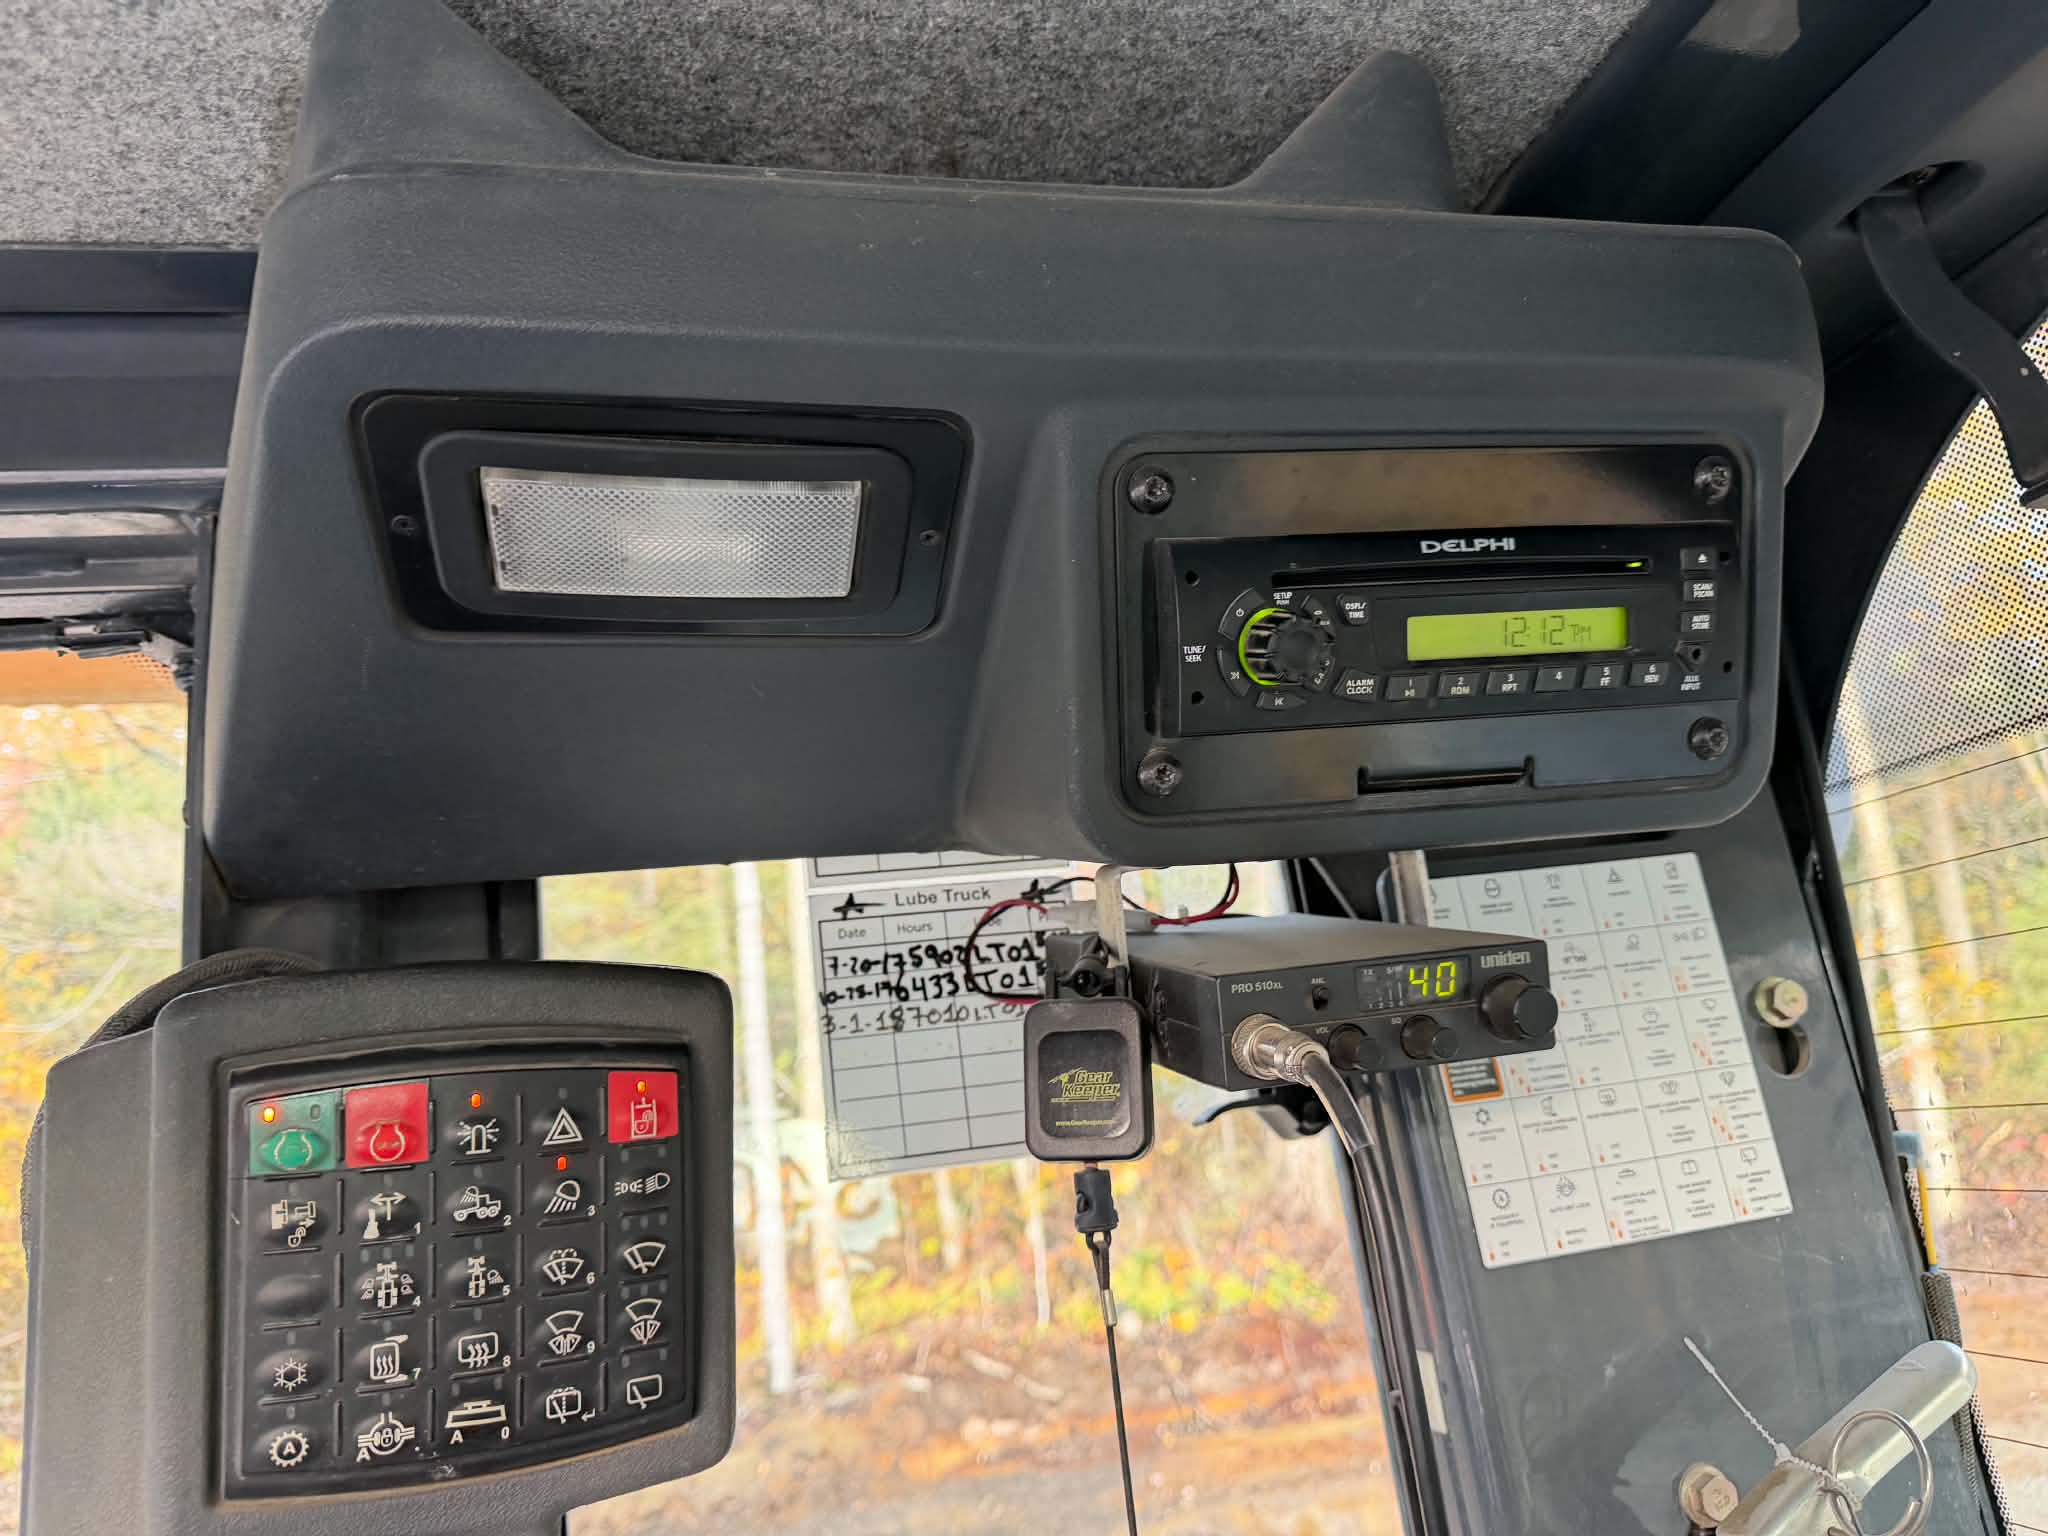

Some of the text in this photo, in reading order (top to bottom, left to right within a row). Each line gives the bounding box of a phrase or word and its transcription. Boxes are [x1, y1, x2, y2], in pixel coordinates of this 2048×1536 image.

[1420, 536, 1517, 554] DELPHI
[1348, 611, 1364, 619] TIME
[1603, 666, 1610, 676] 5
[1649, 664, 1656, 673] 6
[1458, 677, 1464, 685] 2
[1507, 673, 1514, 682] 3
[1555, 671, 1563, 681] 4
[1346, 679, 1374, 688] ALARM
[1346, 686, 1373, 695] CLOCK
[894, 886, 992, 907] Lube Truck
[837, 926, 866, 939] Date
[897, 921, 933, 934] Hours
[1480, 951, 1532, 969] uniden
[1408, 961, 1456, 998] 40
[1231, 983, 1254, 994] PRO
[1075, 1070, 1113, 1084] Gear
[587, 1204, 596, 1217] 3
[503, 1214, 512, 1227] 2
[414, 1222, 421, 1235] 1
[586, 1272, 596, 1286] 6
[502, 1283, 511, 1297] 5
[412, 1295, 421, 1307] 4
[586, 1341, 596, 1354] 9
[502, 1354, 512, 1368] 8
[413, 1368, 421, 1380] 7
